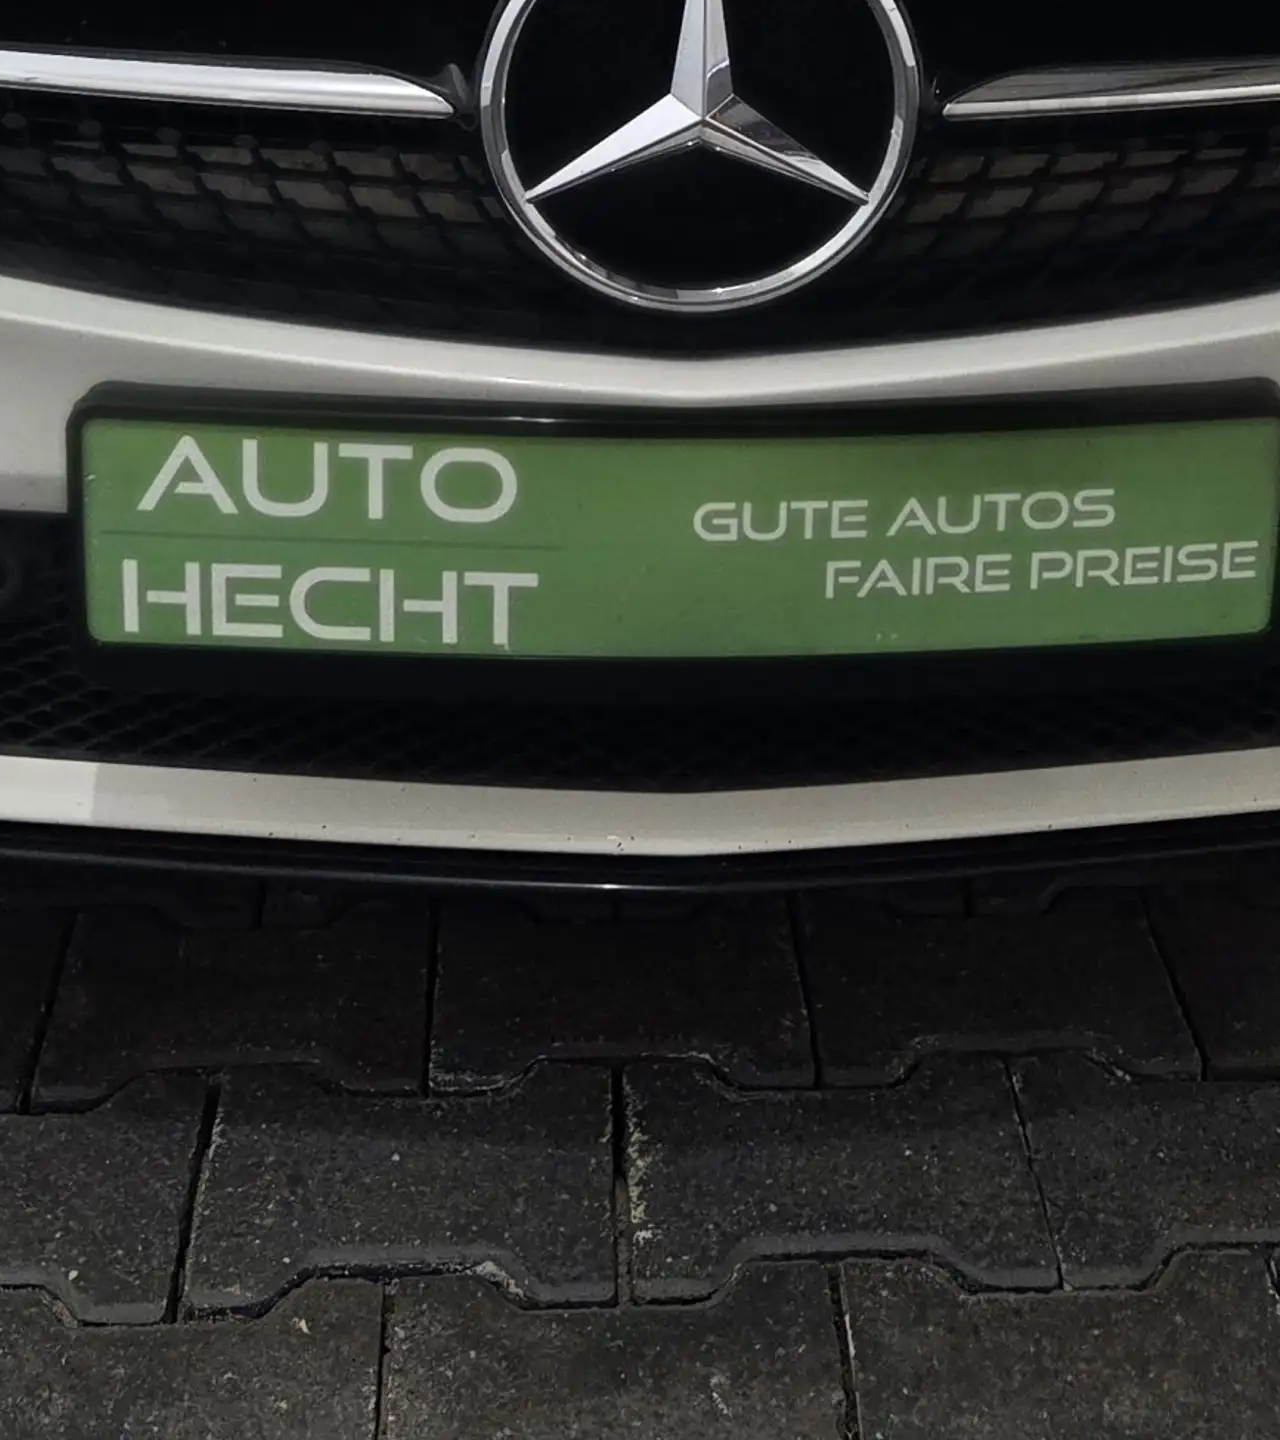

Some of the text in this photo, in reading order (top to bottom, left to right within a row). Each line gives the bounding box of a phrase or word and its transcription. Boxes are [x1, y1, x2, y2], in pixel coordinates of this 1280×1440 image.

[137, 435, 518, 523] AUTO
[693, 488, 1116, 542] GUTE AUTOS
[122, 559, 539, 646] HECHT
[825, 540, 1259, 599] FAIRE PREISE
